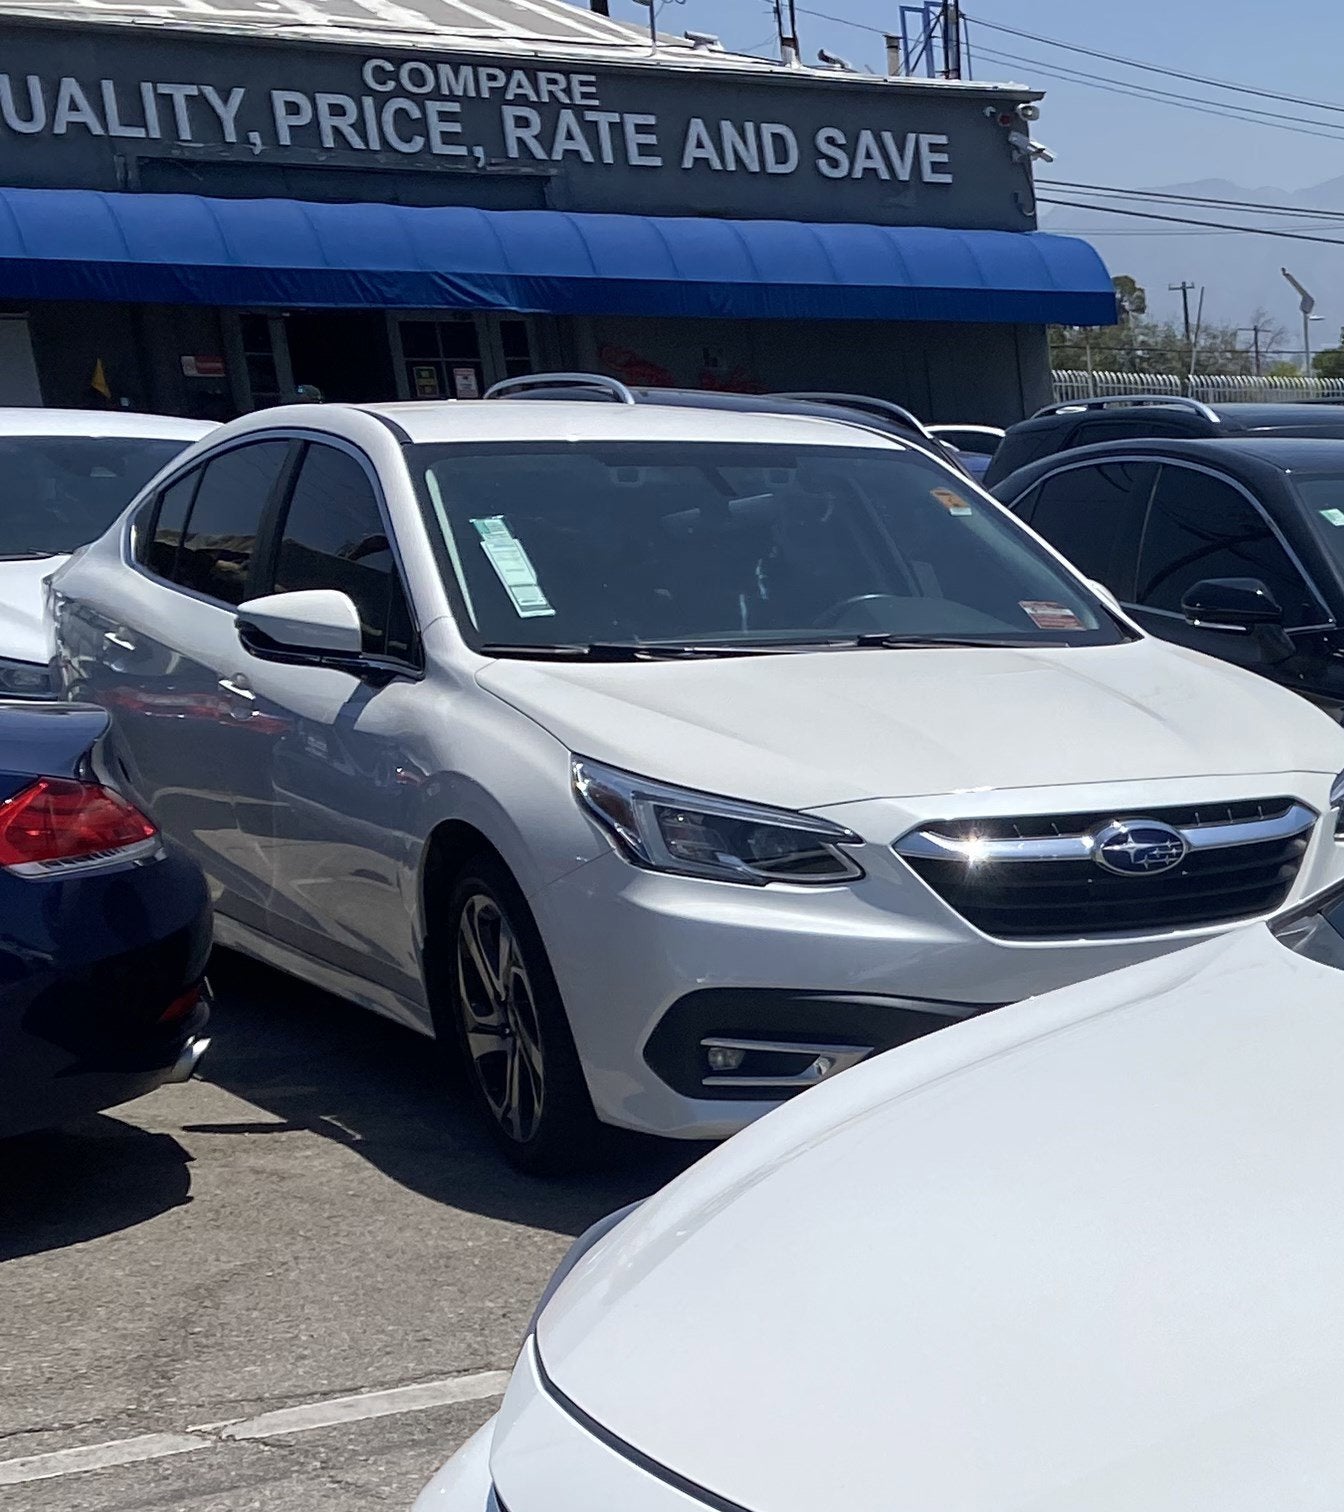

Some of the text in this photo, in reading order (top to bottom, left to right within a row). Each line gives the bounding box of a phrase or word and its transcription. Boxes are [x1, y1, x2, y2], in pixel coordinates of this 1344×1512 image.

[362, 58, 599, 105] COMPARE
[271, 90, 485, 169] PRICE,
[502, 105, 663, 167] RATE
[681, 118, 799, 174] AND
[816, 127, 953, 184] SAVE
